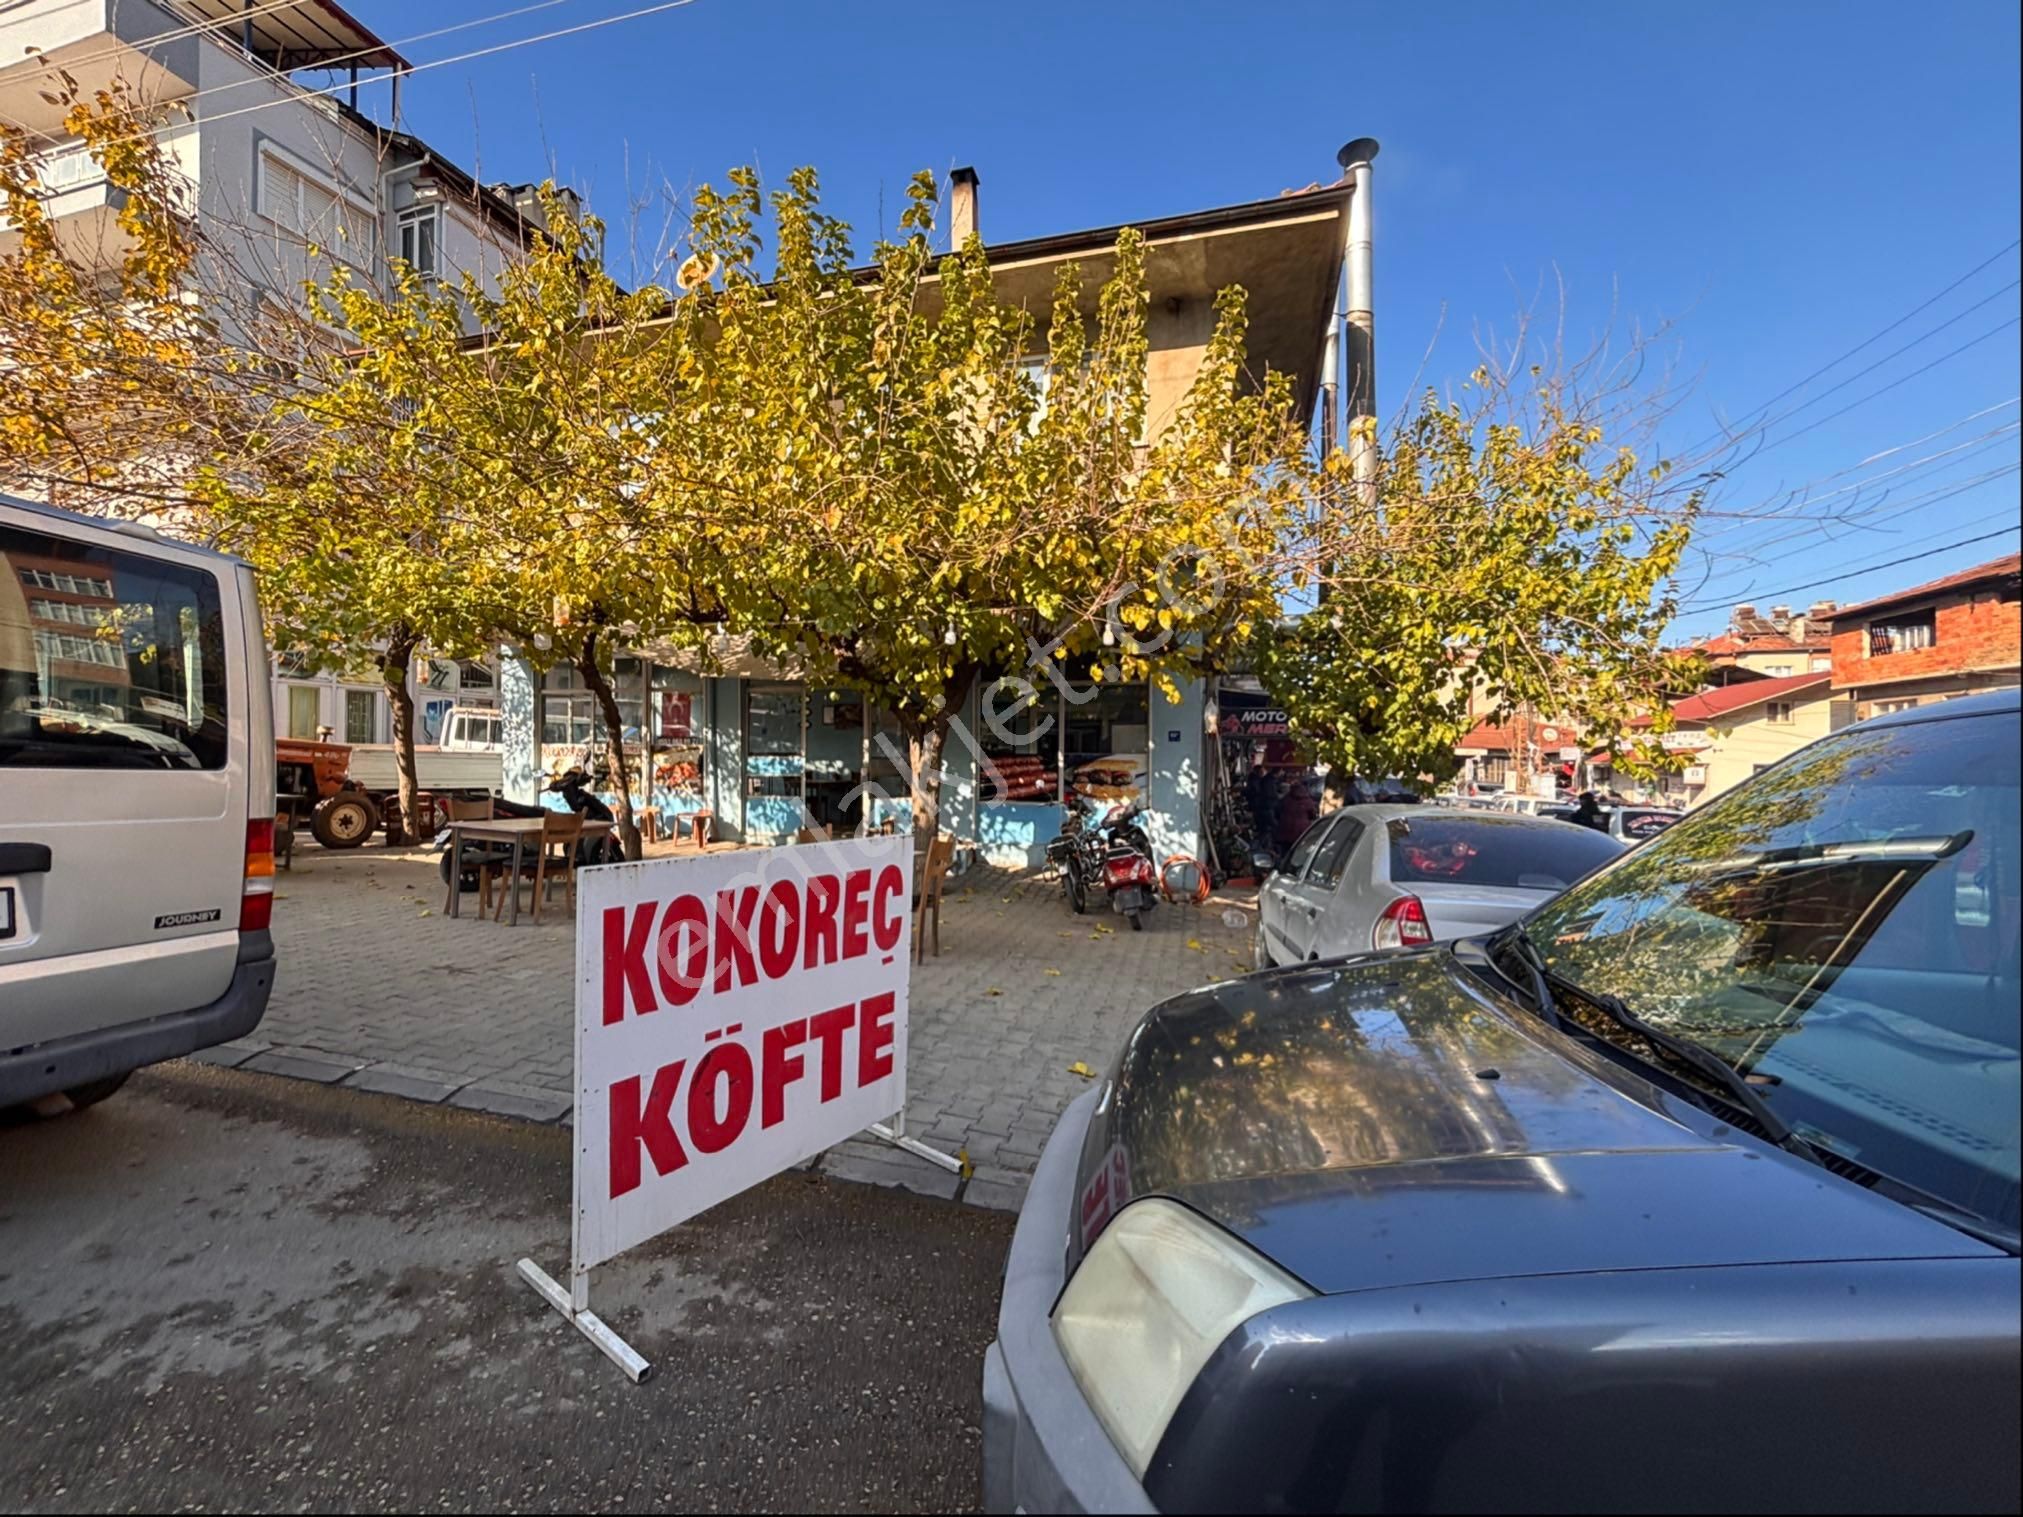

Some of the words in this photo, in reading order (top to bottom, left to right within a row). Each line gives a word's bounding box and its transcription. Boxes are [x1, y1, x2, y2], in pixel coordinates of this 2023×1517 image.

[1241, 711, 1288, 722] MOTO
[159, 911, 217, 927] JOURNEY
[602, 864, 904, 1027] KOKOREÇ
[609, 990, 896, 1200] KÖFTE
